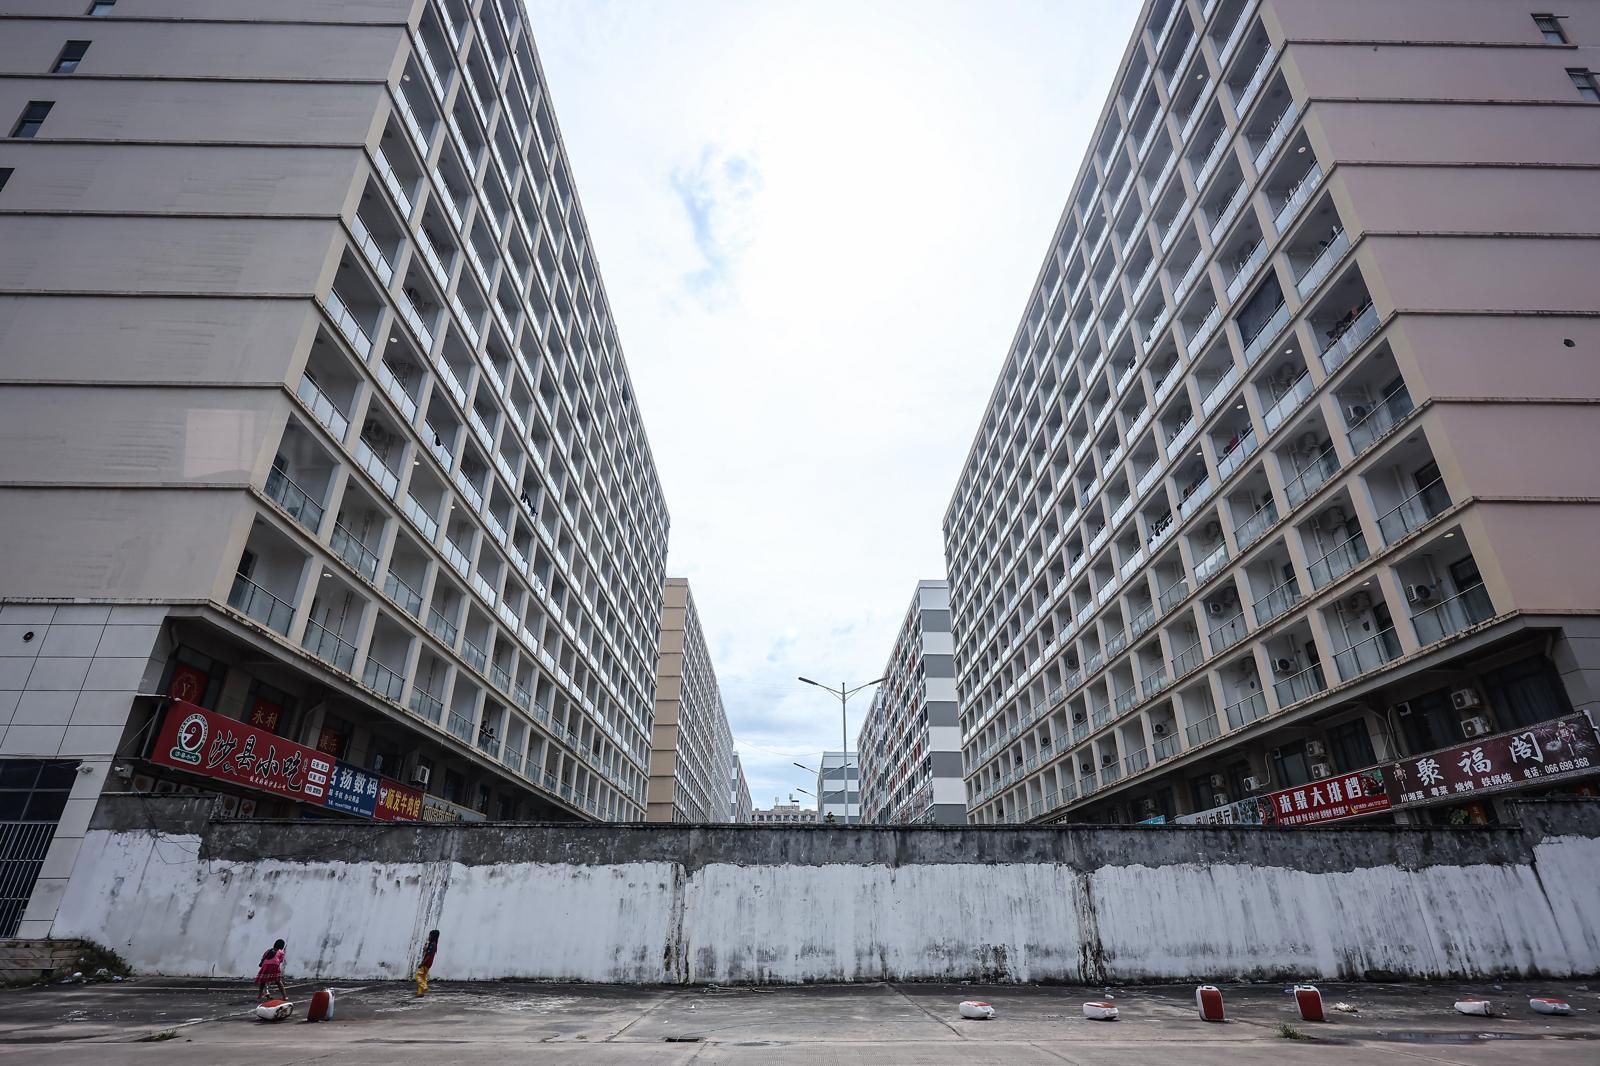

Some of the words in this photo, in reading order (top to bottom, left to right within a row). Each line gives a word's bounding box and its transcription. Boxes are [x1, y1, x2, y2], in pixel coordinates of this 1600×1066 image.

[251, 706, 278, 730] 永利
[206, 730, 302, 792] 沙县小吃
[1416, 731, 1544, 786] 聚福阁
[1574, 757, 1590, 768] 368
[1278, 776, 1363, 814] 来聚大排档
